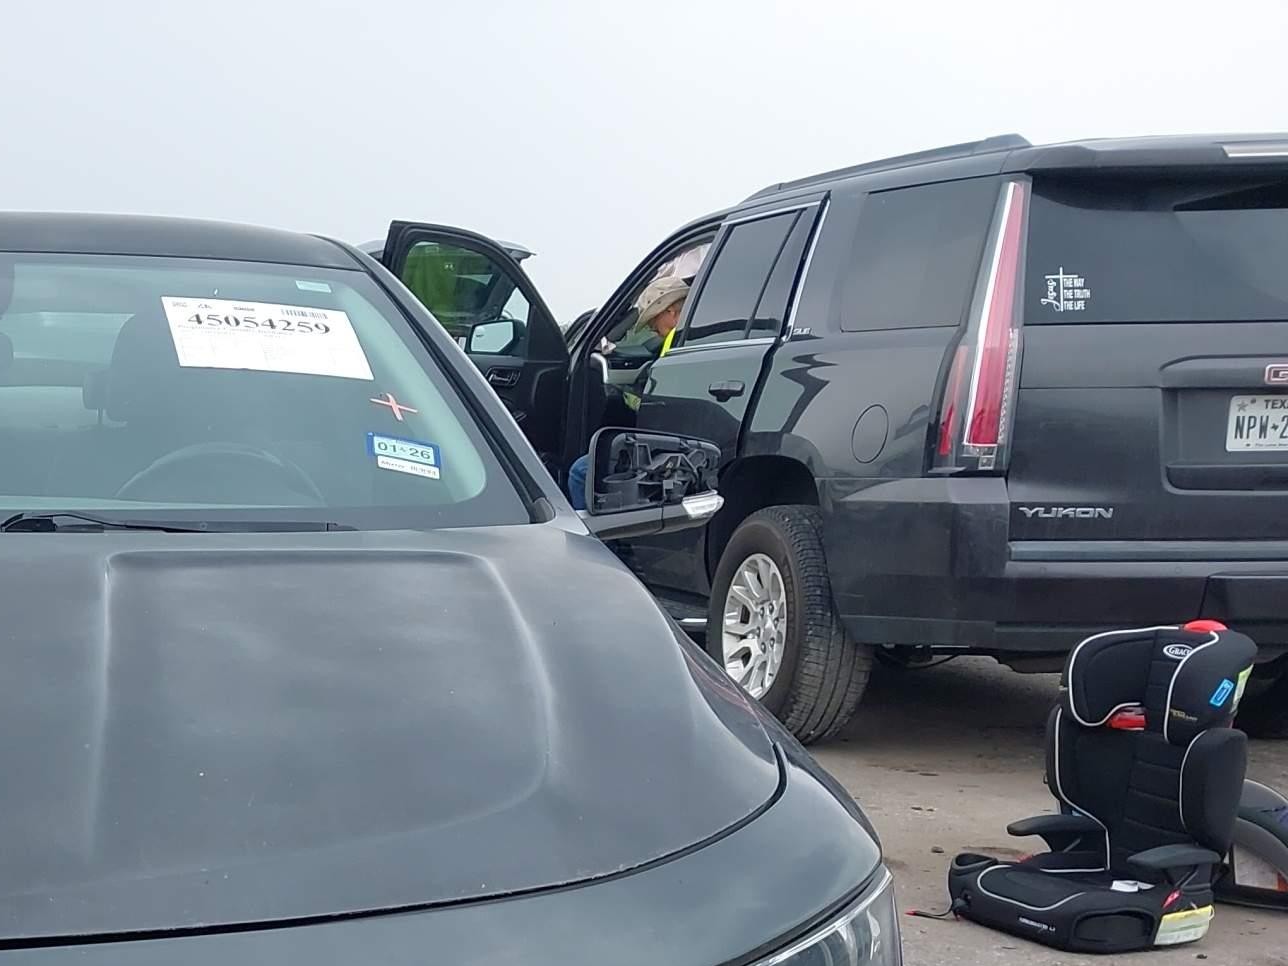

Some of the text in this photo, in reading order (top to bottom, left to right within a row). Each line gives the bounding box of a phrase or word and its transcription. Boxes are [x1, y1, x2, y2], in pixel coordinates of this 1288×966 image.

[1064, 278, 1073, 288] THE
[1064, 288, 1091, 299] THE TRUTH
[1064, 300, 1086, 310] THE LIFE
[187, 312, 331, 335] 45054259
[1234, 415, 1270, 440] NPW
[377, 441, 431, 460] 01 26
[1018, 507, 1114, 519] YUKON
